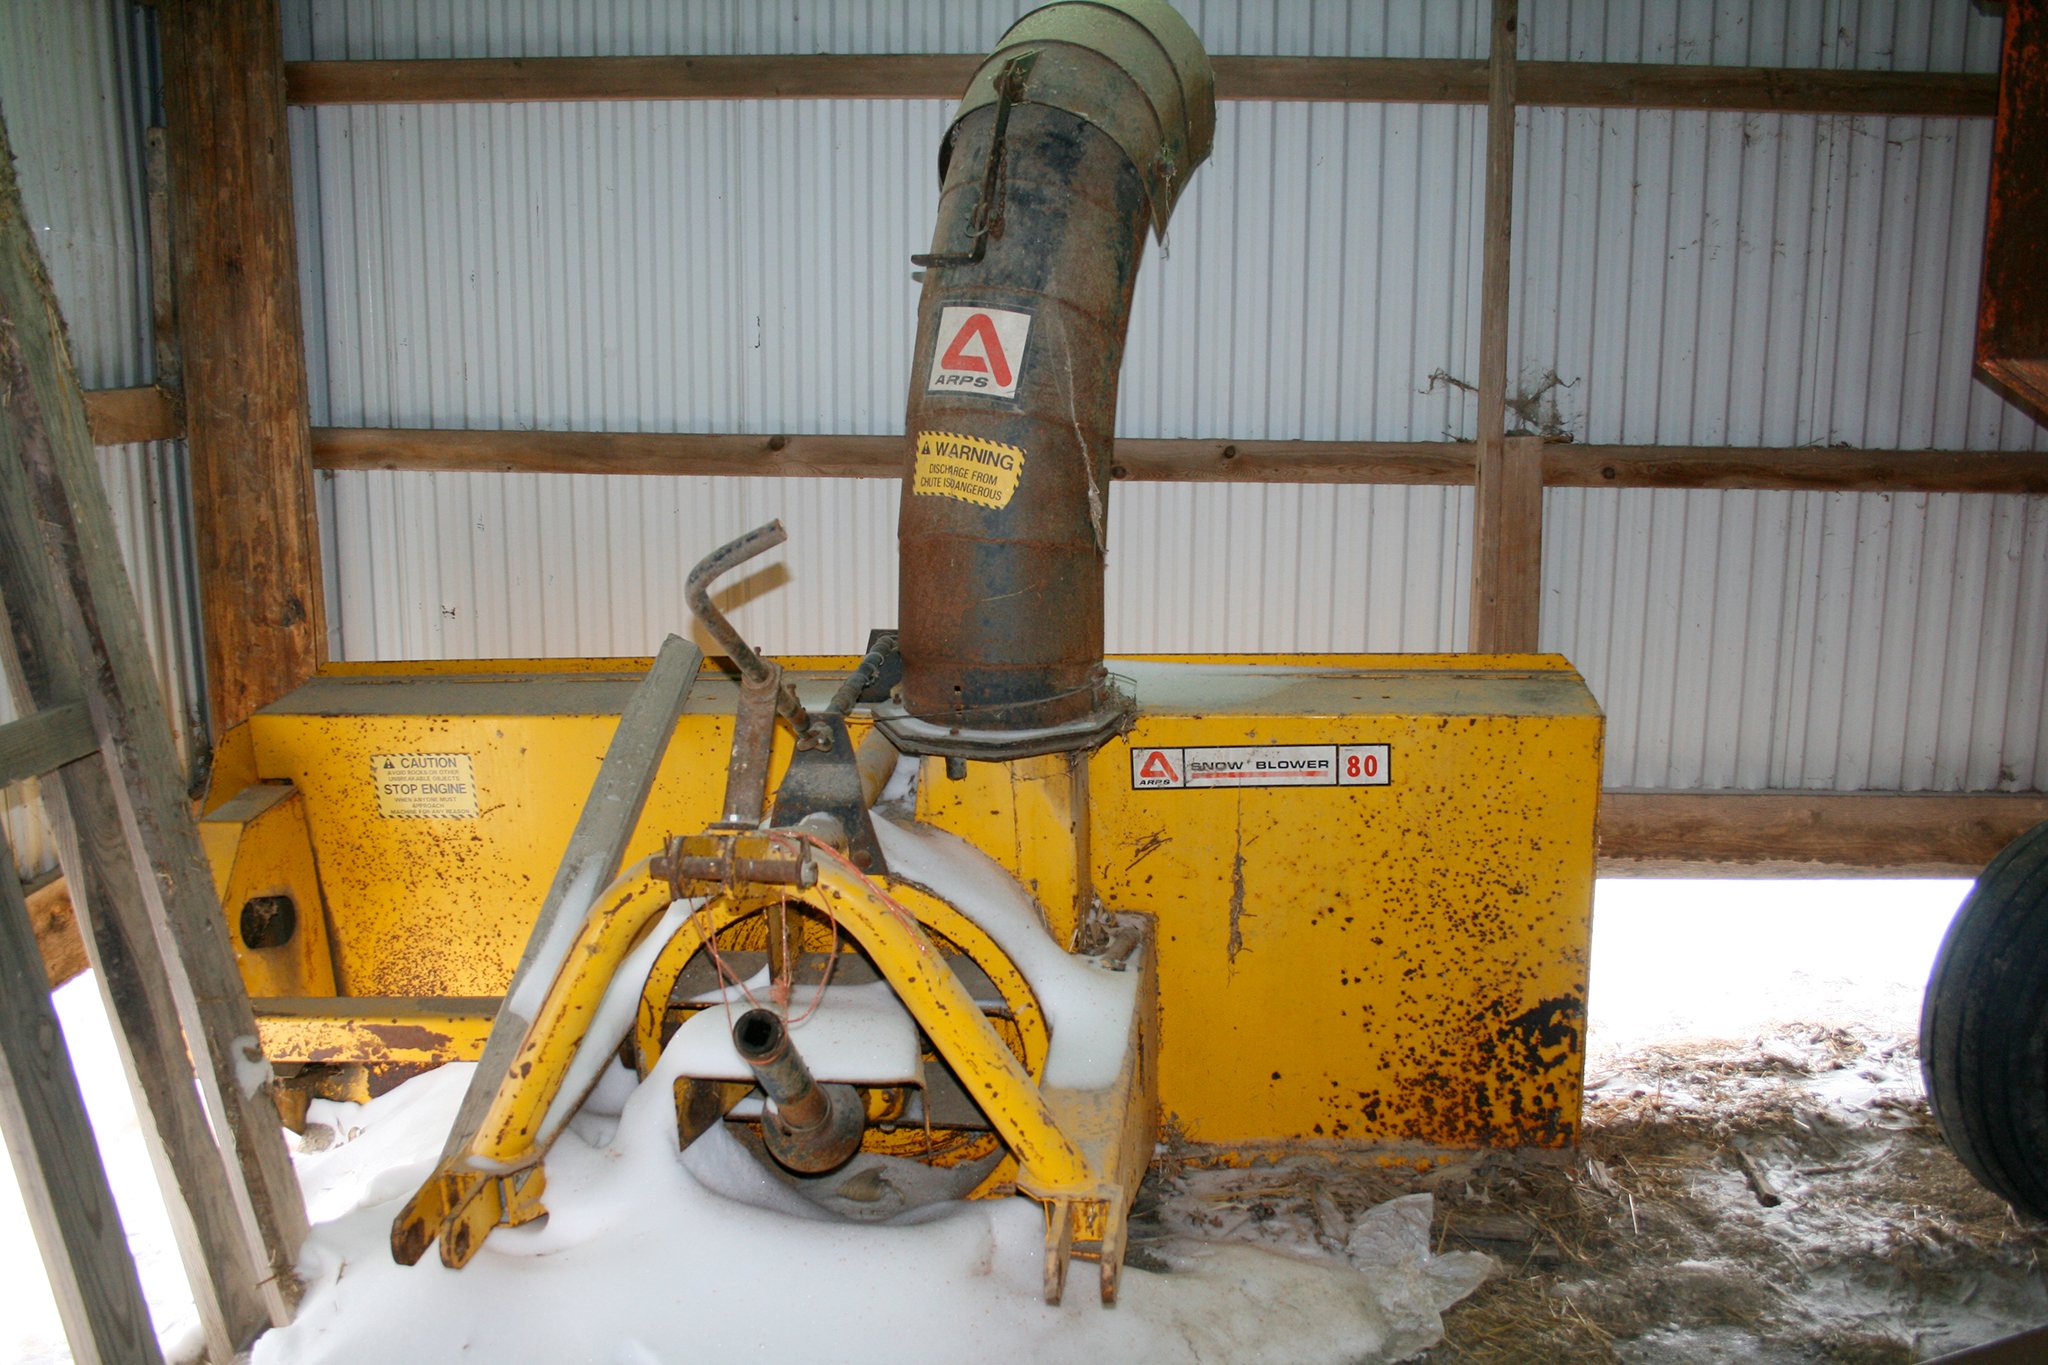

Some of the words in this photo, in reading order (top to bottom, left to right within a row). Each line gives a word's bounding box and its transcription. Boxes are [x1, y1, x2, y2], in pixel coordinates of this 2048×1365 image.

[935, 374, 990, 388] ARPS
[936, 441, 1015, 471] WARNING
[929, 463, 969, 479] DISCHARGE
[971, 471, 998, 486] FROM
[920, 476, 942, 488] CHUTE
[400, 757, 458, 769] CAUTION
[1191, 761, 1244, 771] SNOW
[1255, 760, 1329, 770] BLOWER
[1346, 754, 1378, 778] 80
[384, 783, 418, 795] STOP
[421, 783, 467, 794] ENGINE
